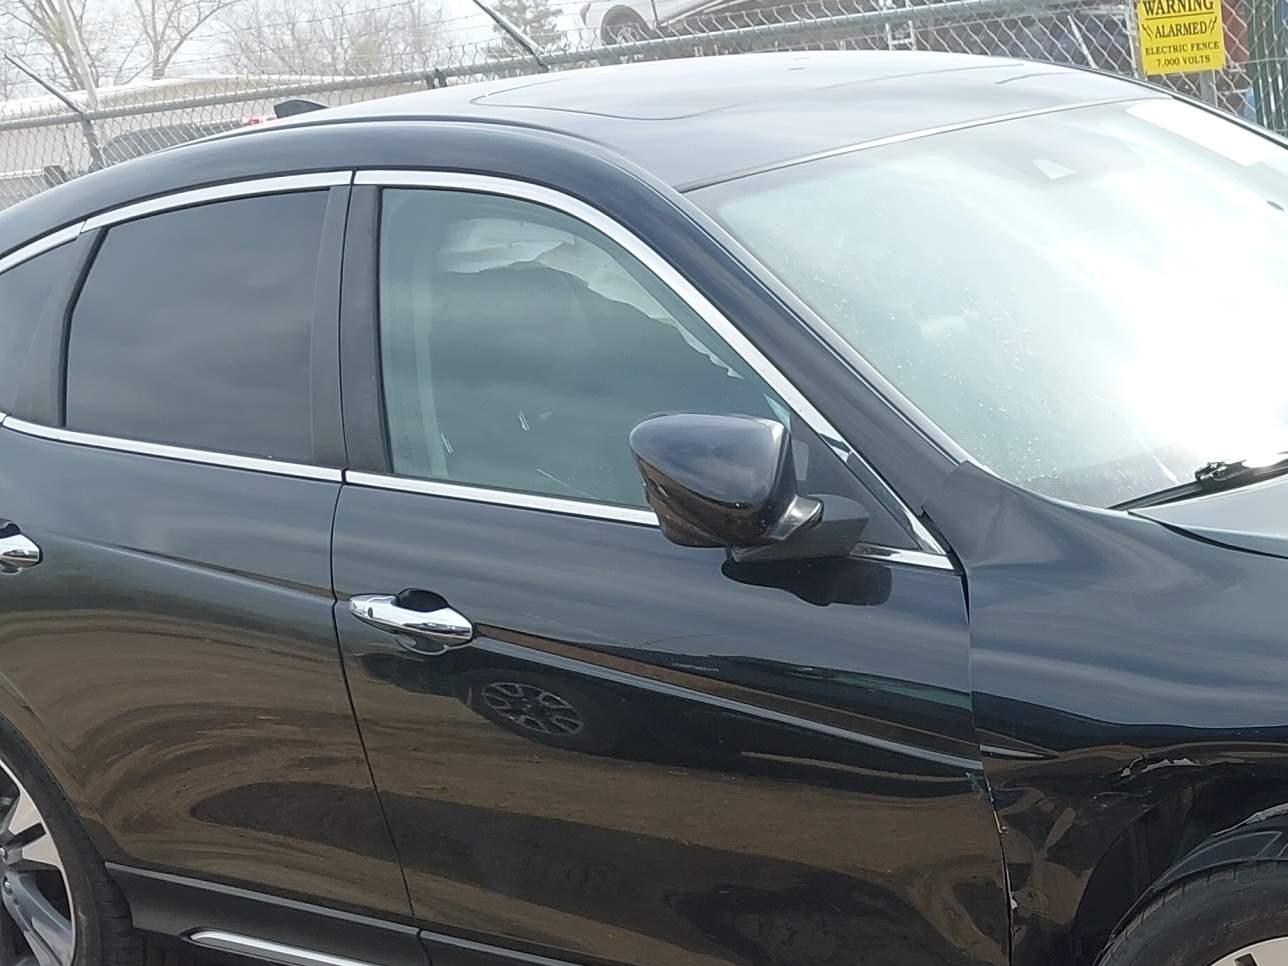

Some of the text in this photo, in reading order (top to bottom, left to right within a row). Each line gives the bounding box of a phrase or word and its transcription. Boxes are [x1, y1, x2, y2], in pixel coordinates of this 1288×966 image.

[1143, 0, 1214, 16] WARNING
[1155, 21, 1207, 38] ALARMED
[1145, 41, 1219, 56] ELECTRIC FENCE
[1182, 55, 1211, 65] VOLTS
